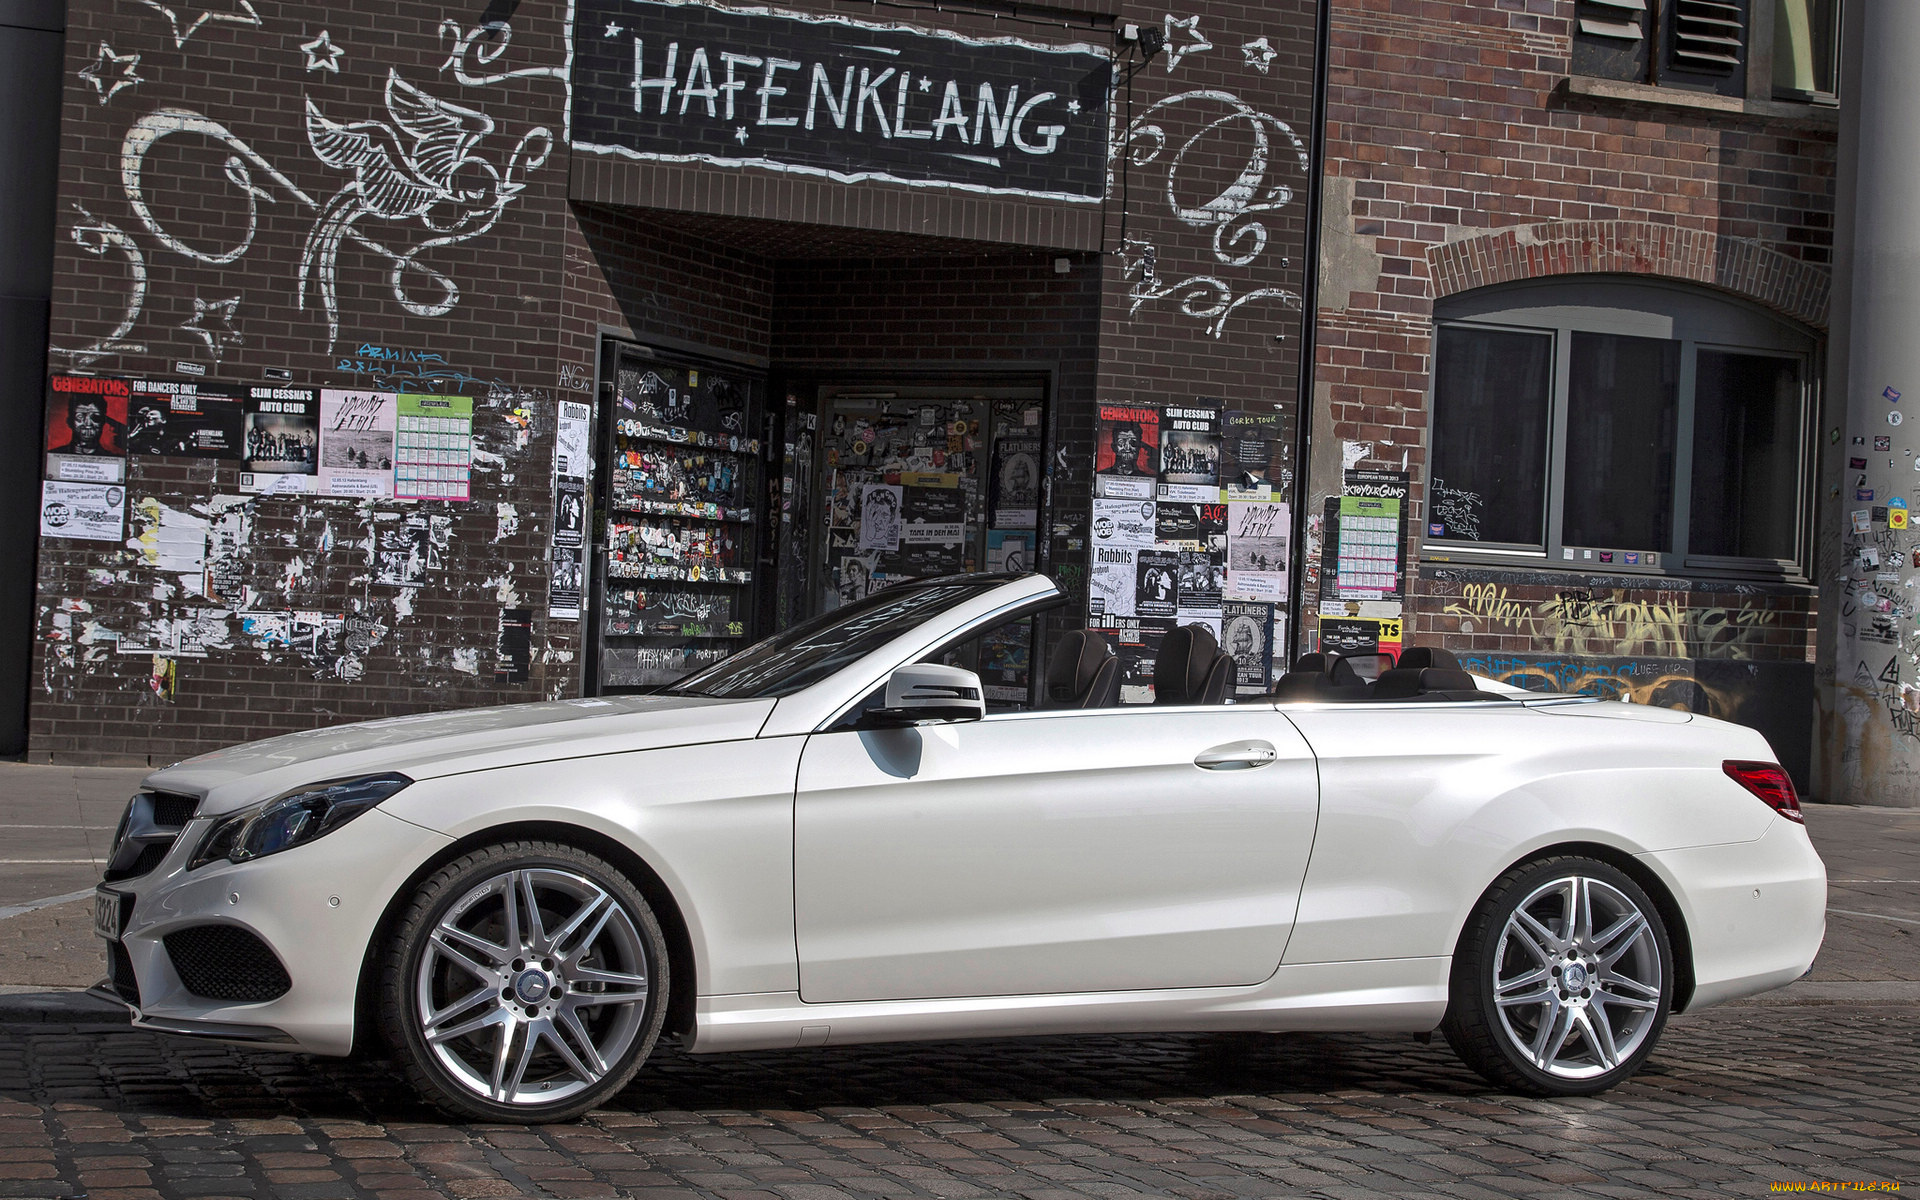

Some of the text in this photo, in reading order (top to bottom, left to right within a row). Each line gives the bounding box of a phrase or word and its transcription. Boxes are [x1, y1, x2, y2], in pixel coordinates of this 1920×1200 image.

[630, 37, 1065, 155] HAFENKLANG
[52, 376, 129, 396] GENERATORS
[133, 380, 197, 395] FOR DANCERS ONLY
[251, 388, 313, 400] SLIM CESSNA'S
[260, 402, 305, 413] AUTO CLUB
[1100, 407, 1159, 424] GENERATORS
[1166, 408, 1215, 419] SLIM CESSNA'S
[1173, 420, 1209, 431] AUTO CLUB
[1257, 416, 1276, 424] TOUR
[1000, 443, 1040, 452] FLATLINERS
[45, 507, 68, 517] WOB
[1095, 520, 1113, 529] WOB
[926, 529, 932, 537] IN
[933, 529, 946, 537] DEN
[946, 529, 960, 537] MAI
[1098, 547, 1132, 564] Rabbits
[1222, 605, 1267, 616] FLATLINERS
[1089, 617, 1100, 628] FOR
[1127, 619, 1140, 629] ONLY
